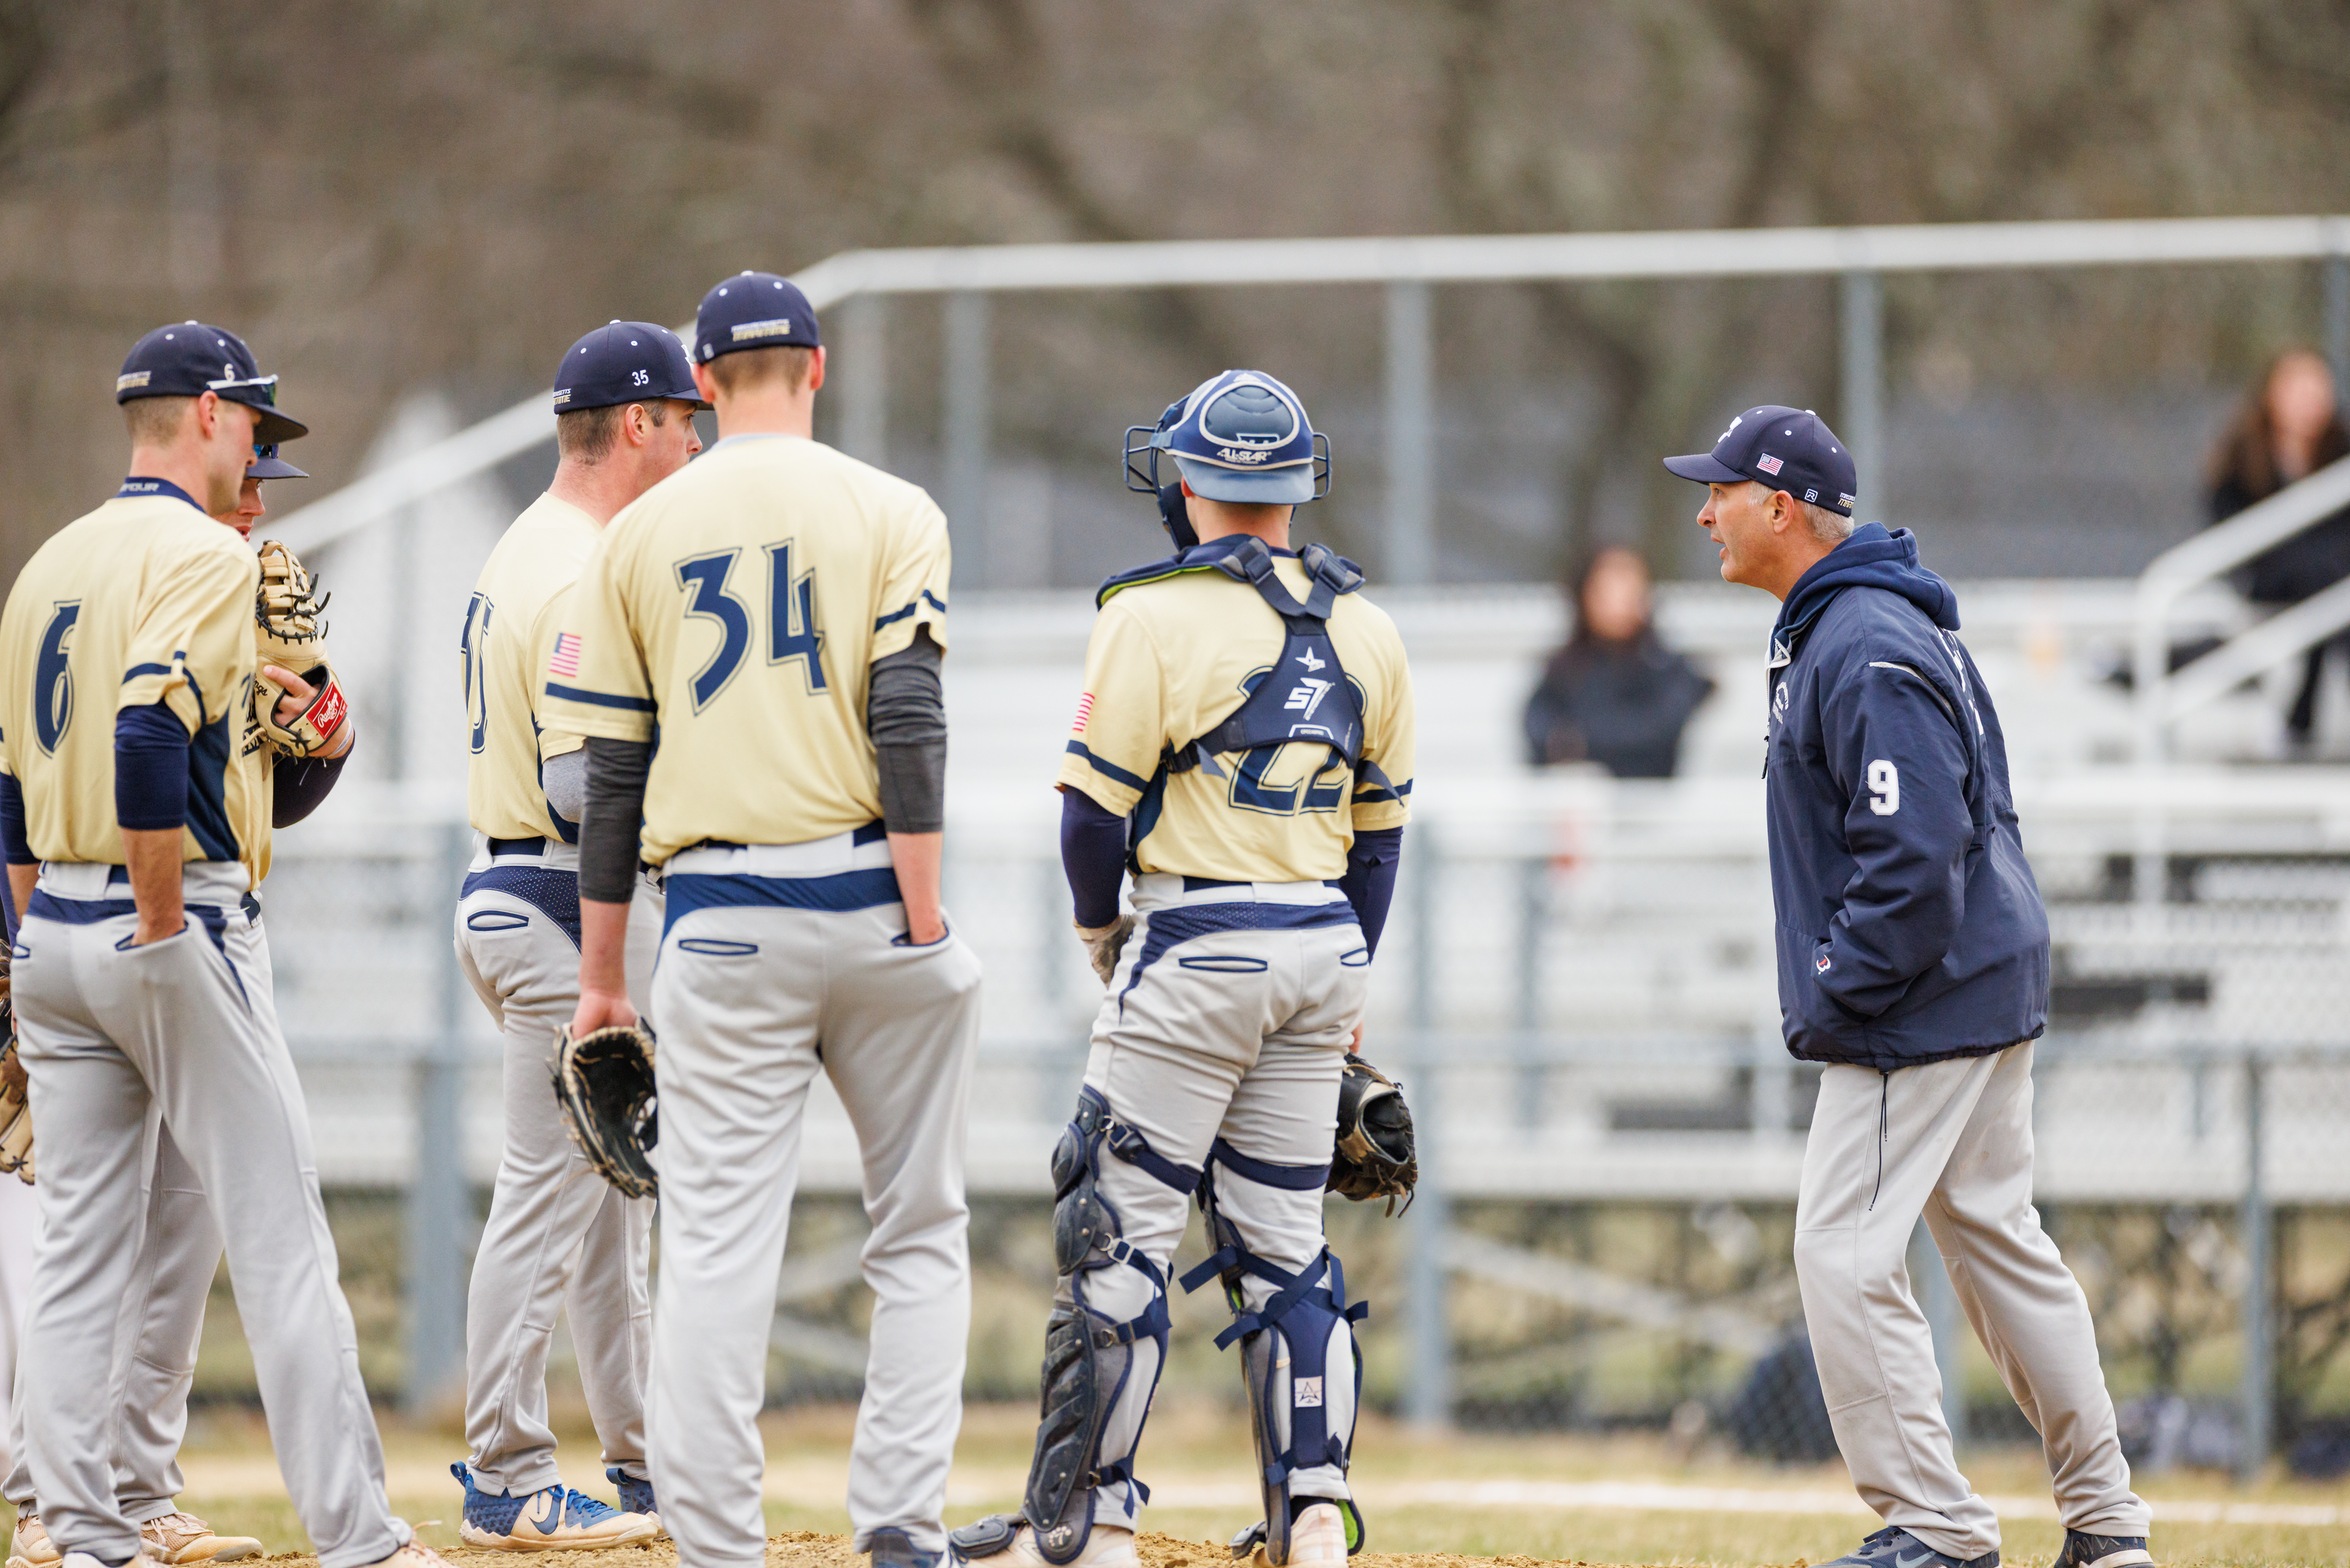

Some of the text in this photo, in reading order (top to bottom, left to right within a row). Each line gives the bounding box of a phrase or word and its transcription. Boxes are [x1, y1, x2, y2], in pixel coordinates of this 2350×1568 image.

[223, 363, 235, 382] 6
[631, 369, 649, 387] 35
[673, 537, 830, 717] 34
[31, 598, 82, 759] 6
[1283, 677, 1333, 721] S7
[1867, 759, 1900, 816] 9
